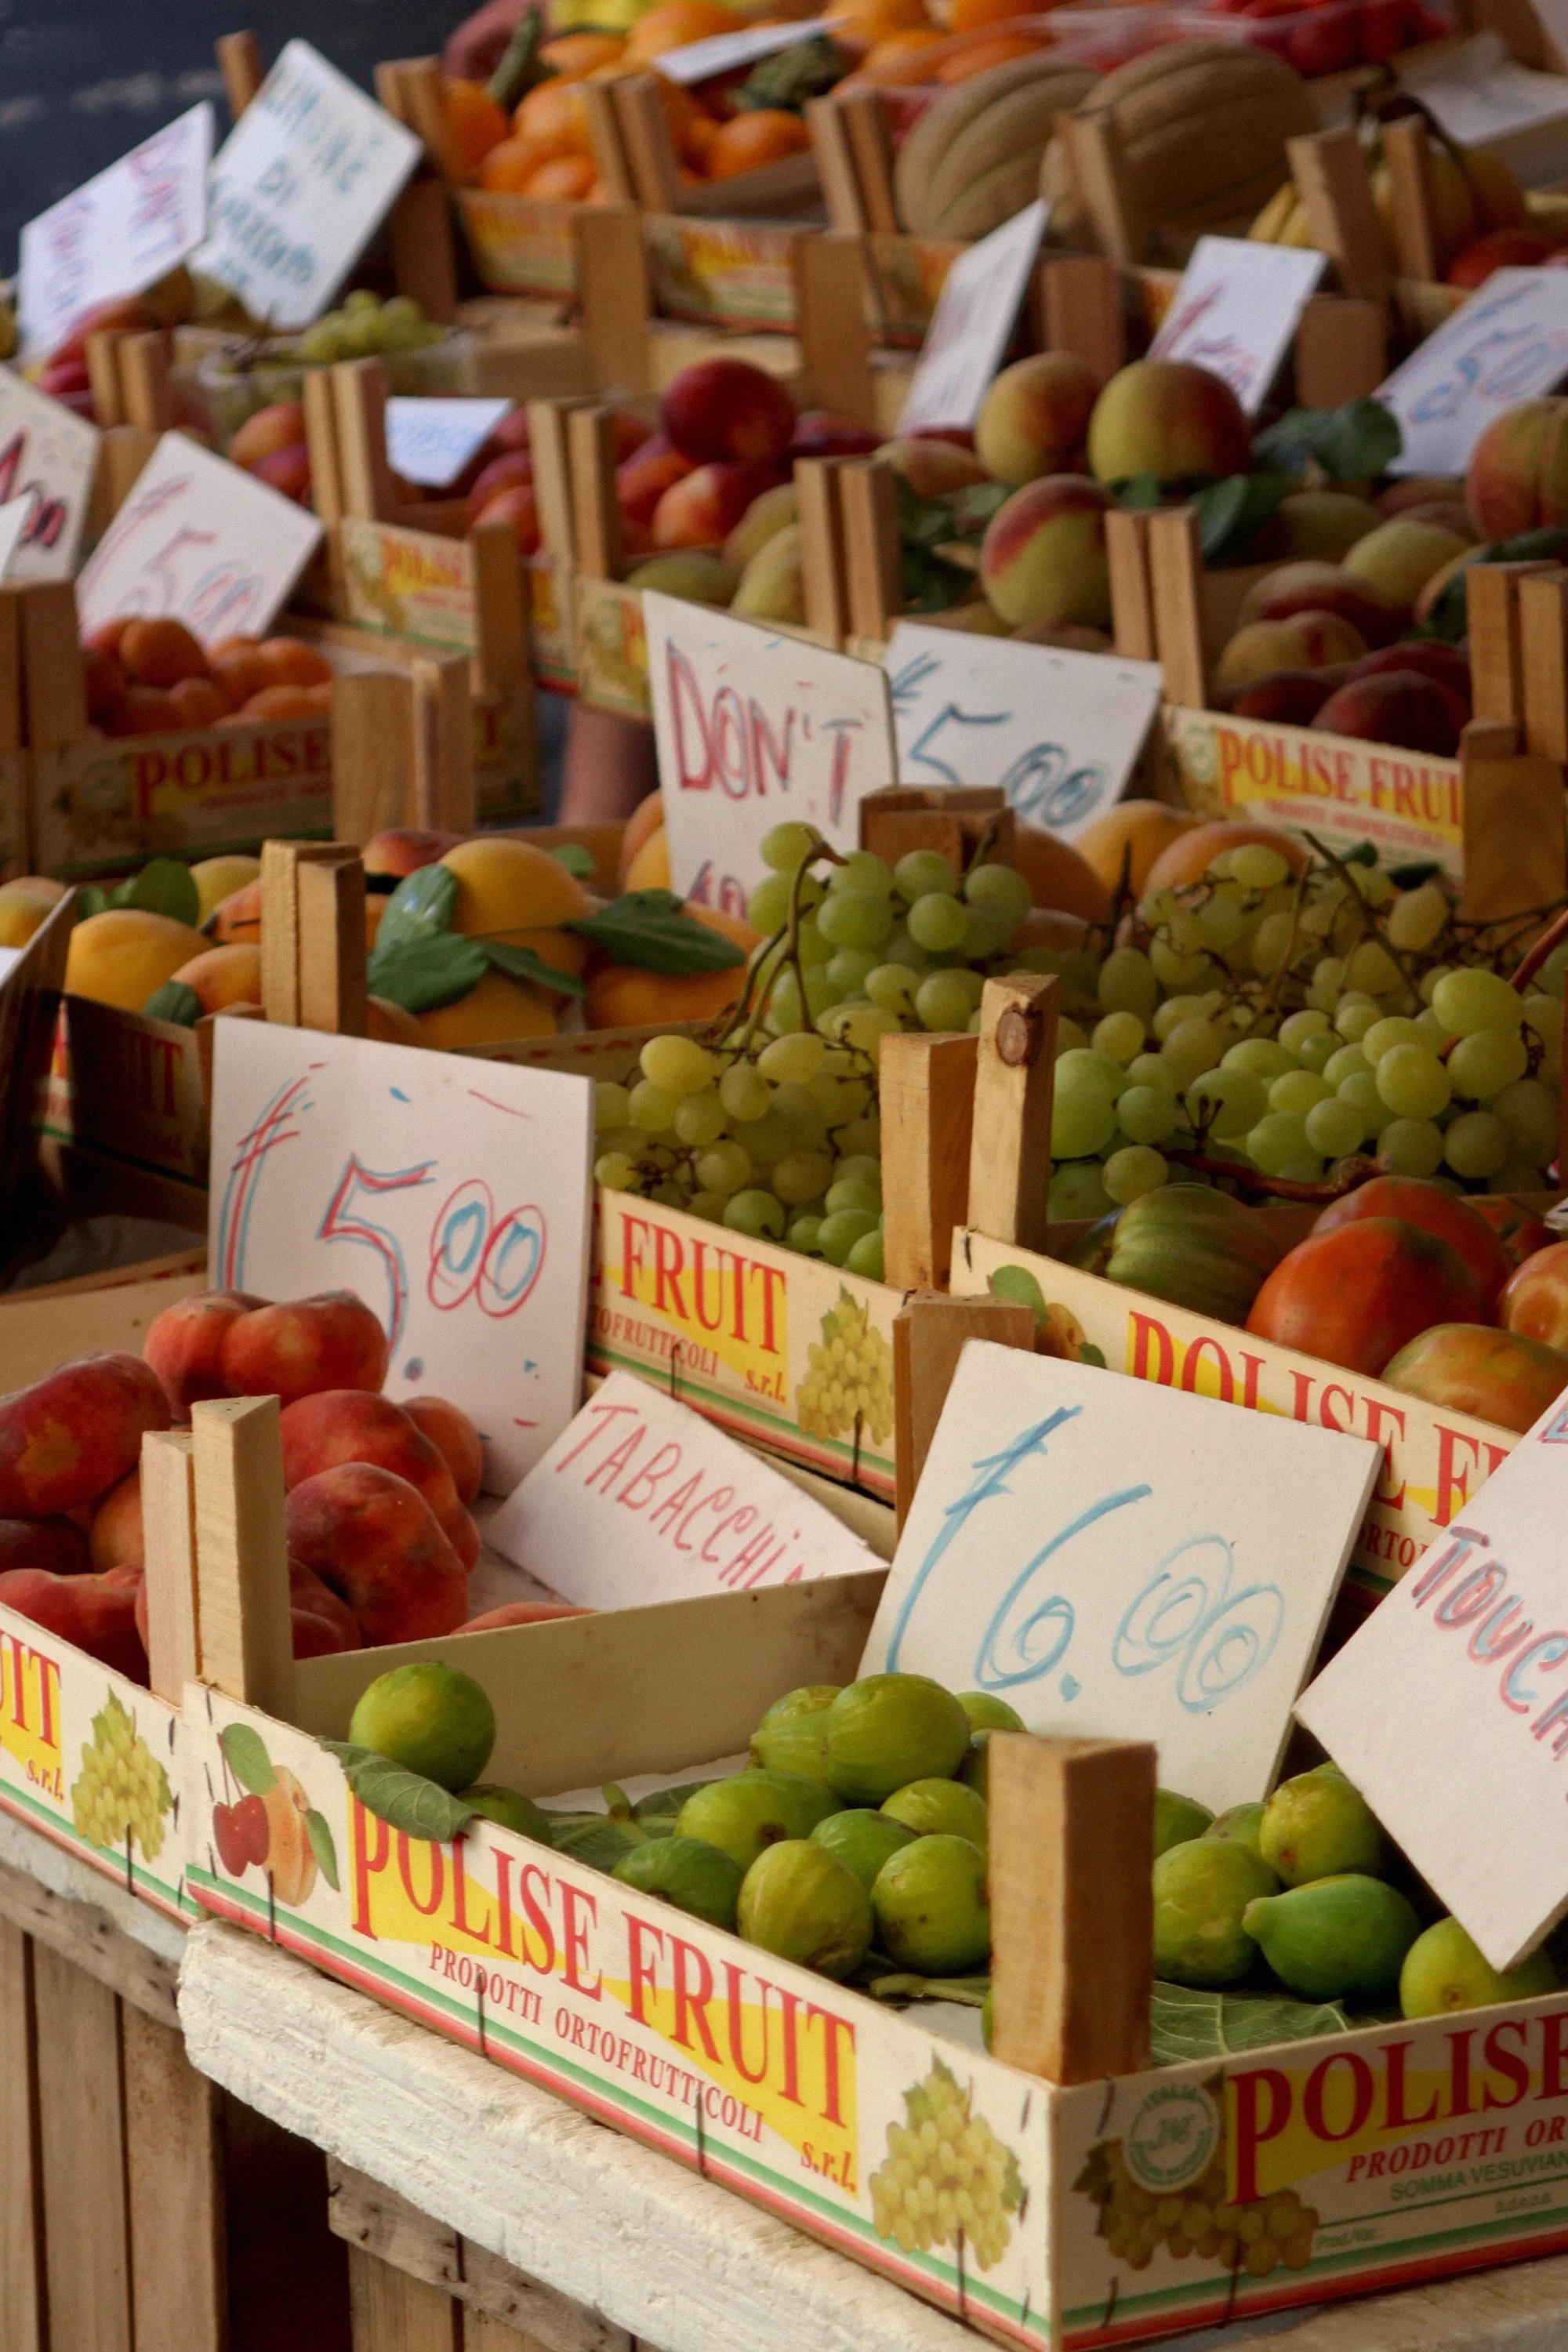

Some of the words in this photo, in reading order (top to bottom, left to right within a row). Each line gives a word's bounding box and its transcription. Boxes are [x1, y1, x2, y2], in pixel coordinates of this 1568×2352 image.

[666, 636, 864, 828] DON'T
[1218, 726, 1359, 806] POLISE
[618, 1210, 787, 1355] FRUIT
[350, 1794, 603, 2003] POLISE
[621, 1910, 857, 2129] FRUIT
[430, 1940, 543, 2026] PRODOTTI
[554, 2006, 764, 2143] ORTOFRUTTICOLI
[800, 2140, 857, 2193] s.r.l.
[1345, 2125, 1508, 2183] PRODOTTI
